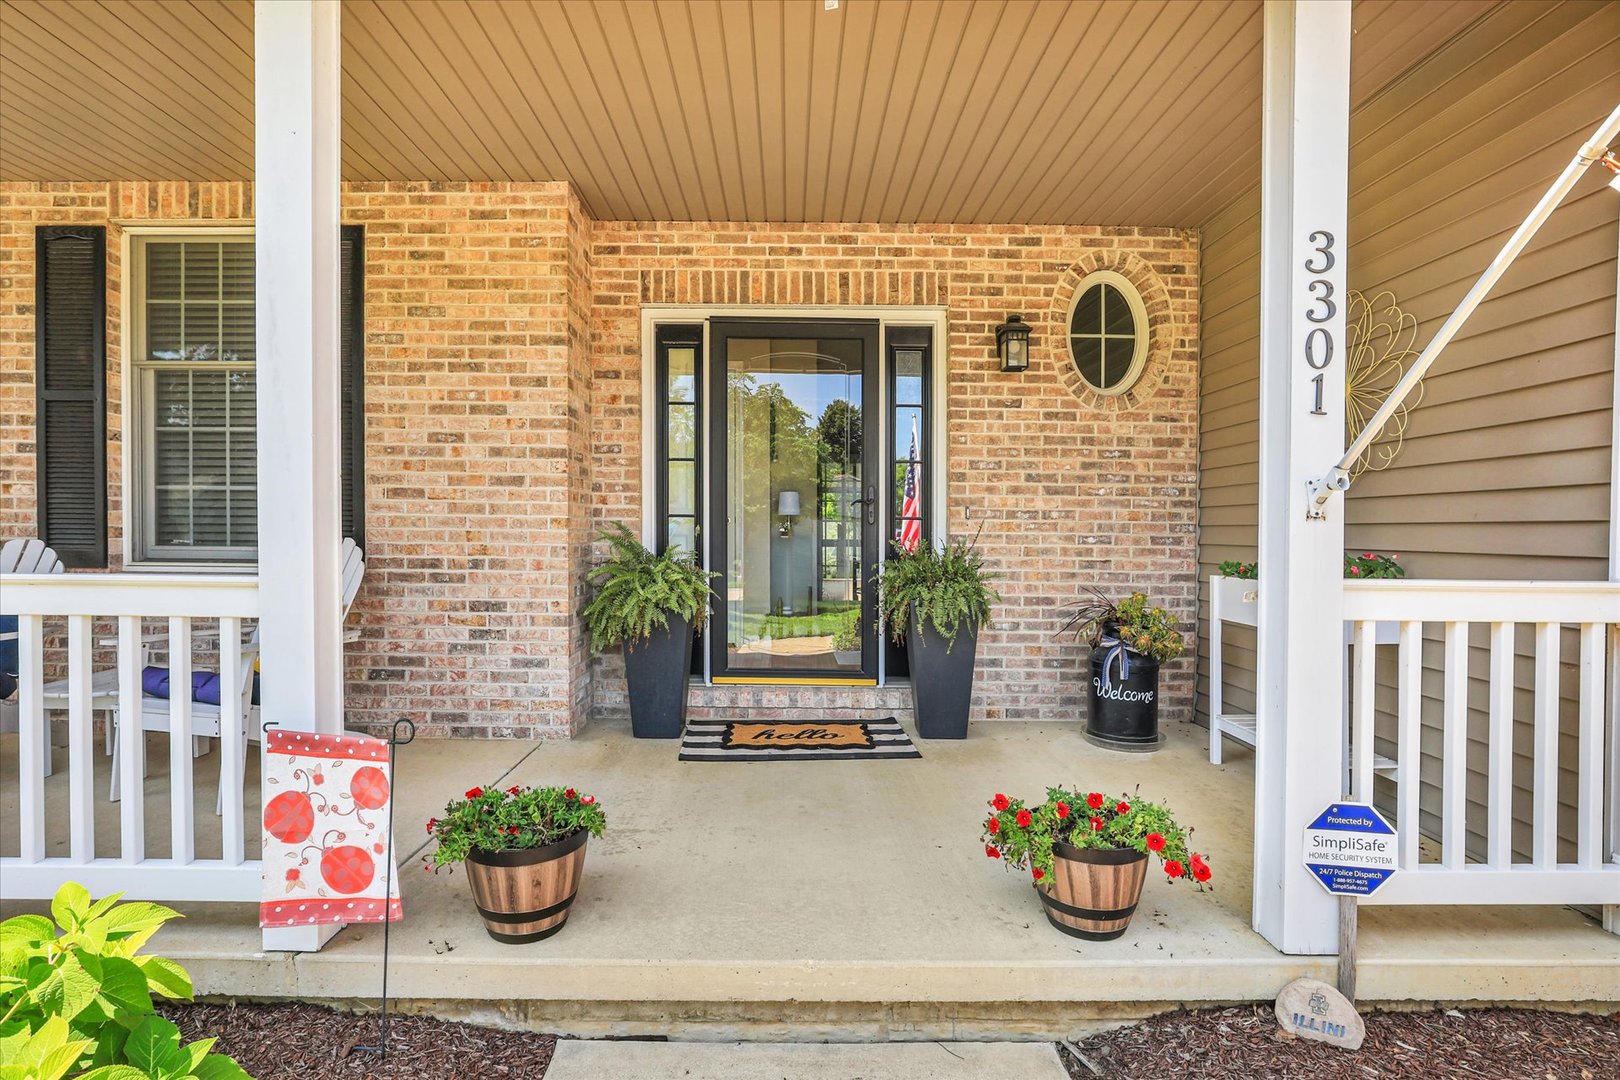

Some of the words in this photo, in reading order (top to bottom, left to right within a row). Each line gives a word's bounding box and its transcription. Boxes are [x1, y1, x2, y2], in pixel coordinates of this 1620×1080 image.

[1305, 230, 1337, 415] 3301
[1093, 677, 1154, 703] Welcome
[751, 729, 845, 740] hello
[1327, 816, 1362, 825] Protected
[1363, 818, 1373, 828] by
[1308, 852, 1330, 860] HOME
[1331, 854, 1364, 863] SECURITY
[1365, 857, 1393, 865] SYSTEM
[1334, 869, 1353, 877] Police
[1354, 870, 1383, 879] Dispatch
[1332, 883, 1369, 891] SimpliSafe.com
[1292, 1012, 1346, 1038] ILLINI
